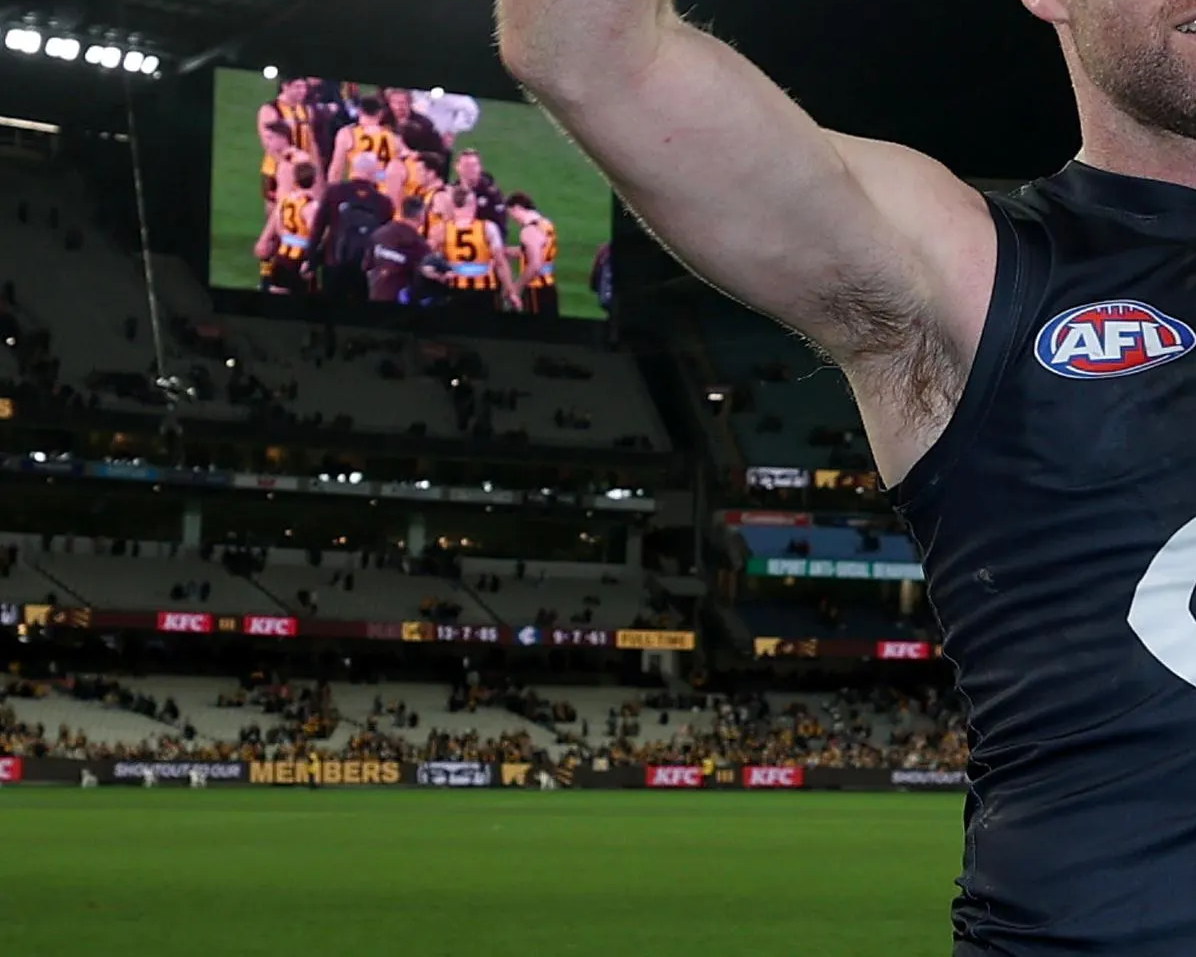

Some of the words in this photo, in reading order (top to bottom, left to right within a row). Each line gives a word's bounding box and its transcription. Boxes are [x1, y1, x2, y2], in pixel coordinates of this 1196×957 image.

[456, 229, 477, 262] 5
[1050, 320, 1185, 364] AFL
[163, 613, 205, 631] KFC
[250, 617, 289, 635] KFC
[884, 642, 922, 658] KFC
[251, 762, 400, 783] MEMBERS
[654, 767, 700, 786] KFC
[751, 768, 794, 786] KFC
